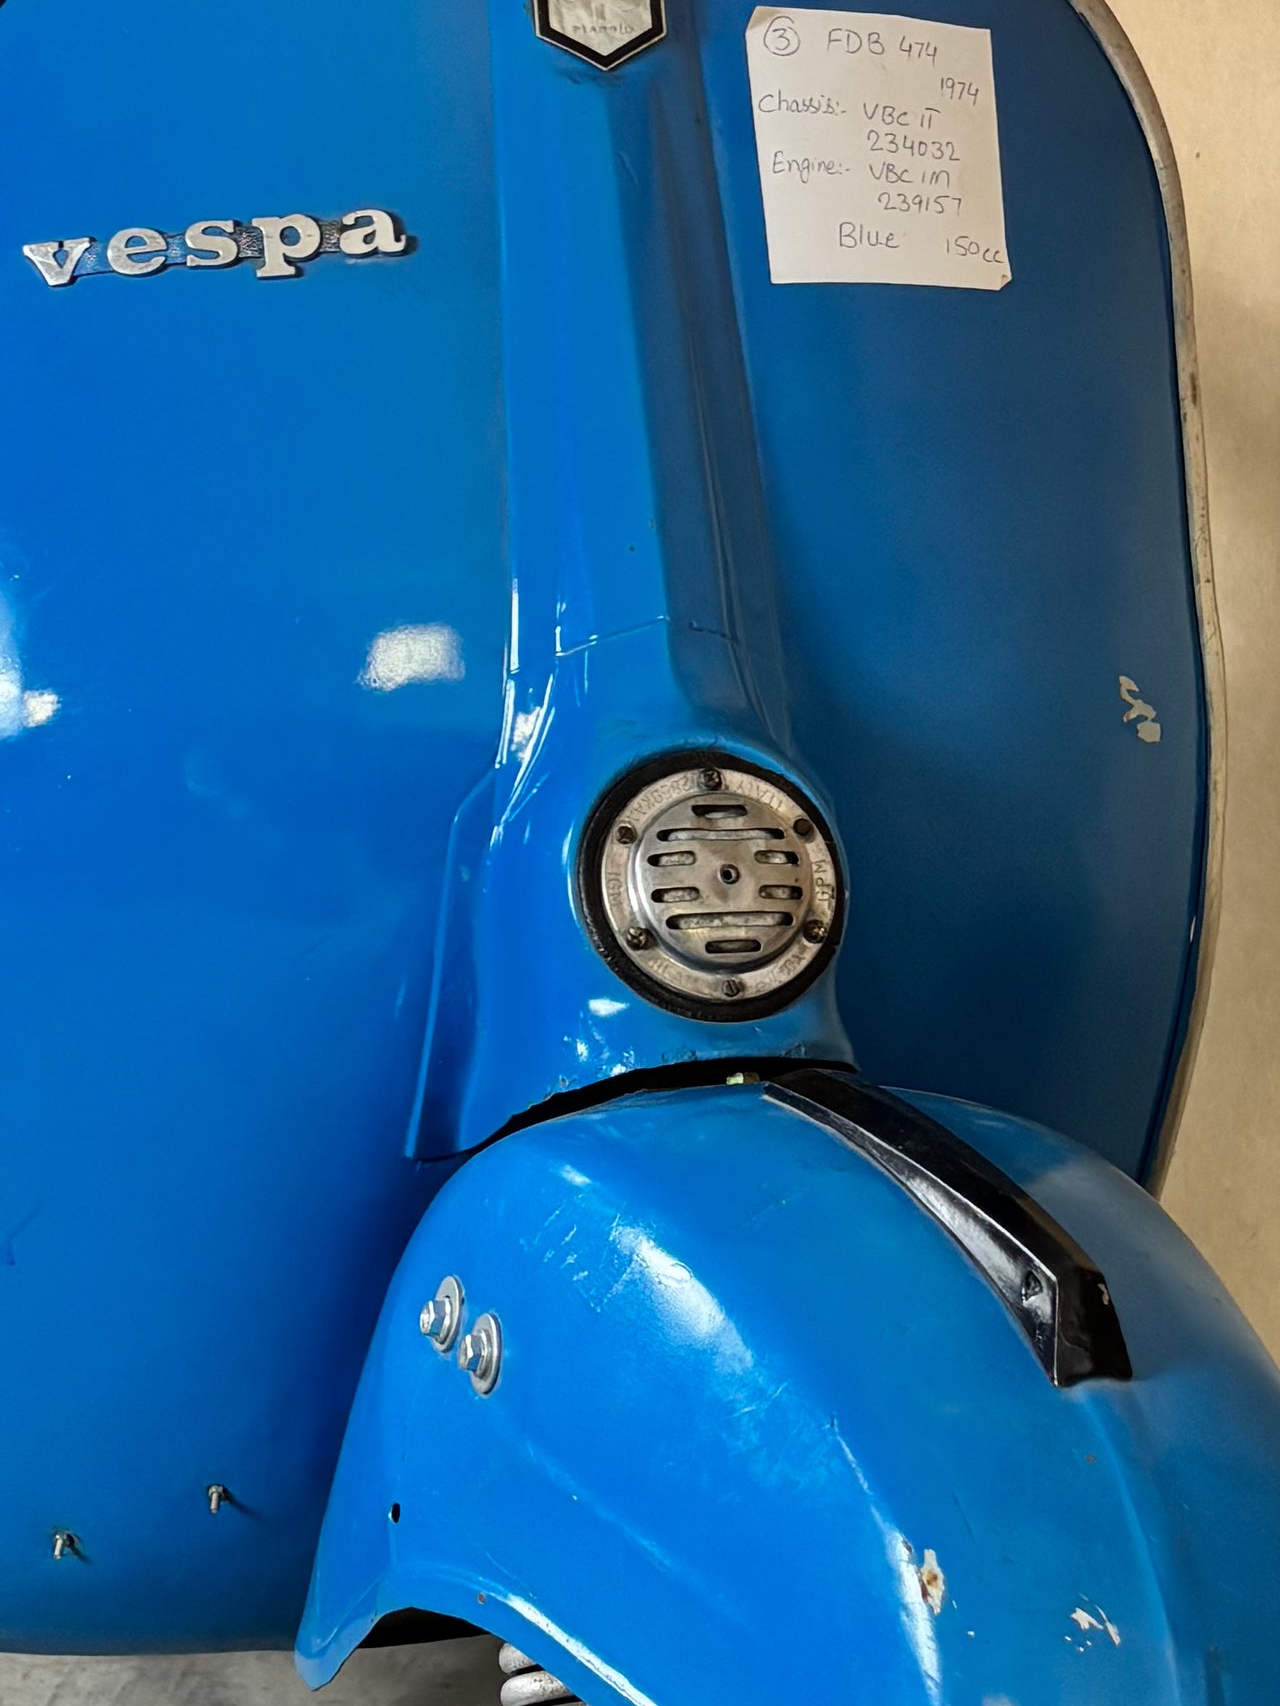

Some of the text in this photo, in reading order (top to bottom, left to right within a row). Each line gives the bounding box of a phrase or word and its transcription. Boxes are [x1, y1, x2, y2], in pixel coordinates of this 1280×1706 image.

[826, 27, 887, 56] FDB
[898, 35, 938, 67] 474
[939, 76, 980, 106] 1974
[862, 101, 910, 127] VBC
[866, 129, 961, 161] 234032
[869, 161, 914, 184] VBC
[877, 191, 962, 216] 239157
[22, 207, 409, 288] vespa
[838, 221, 1007, 264] Blue 150cc
